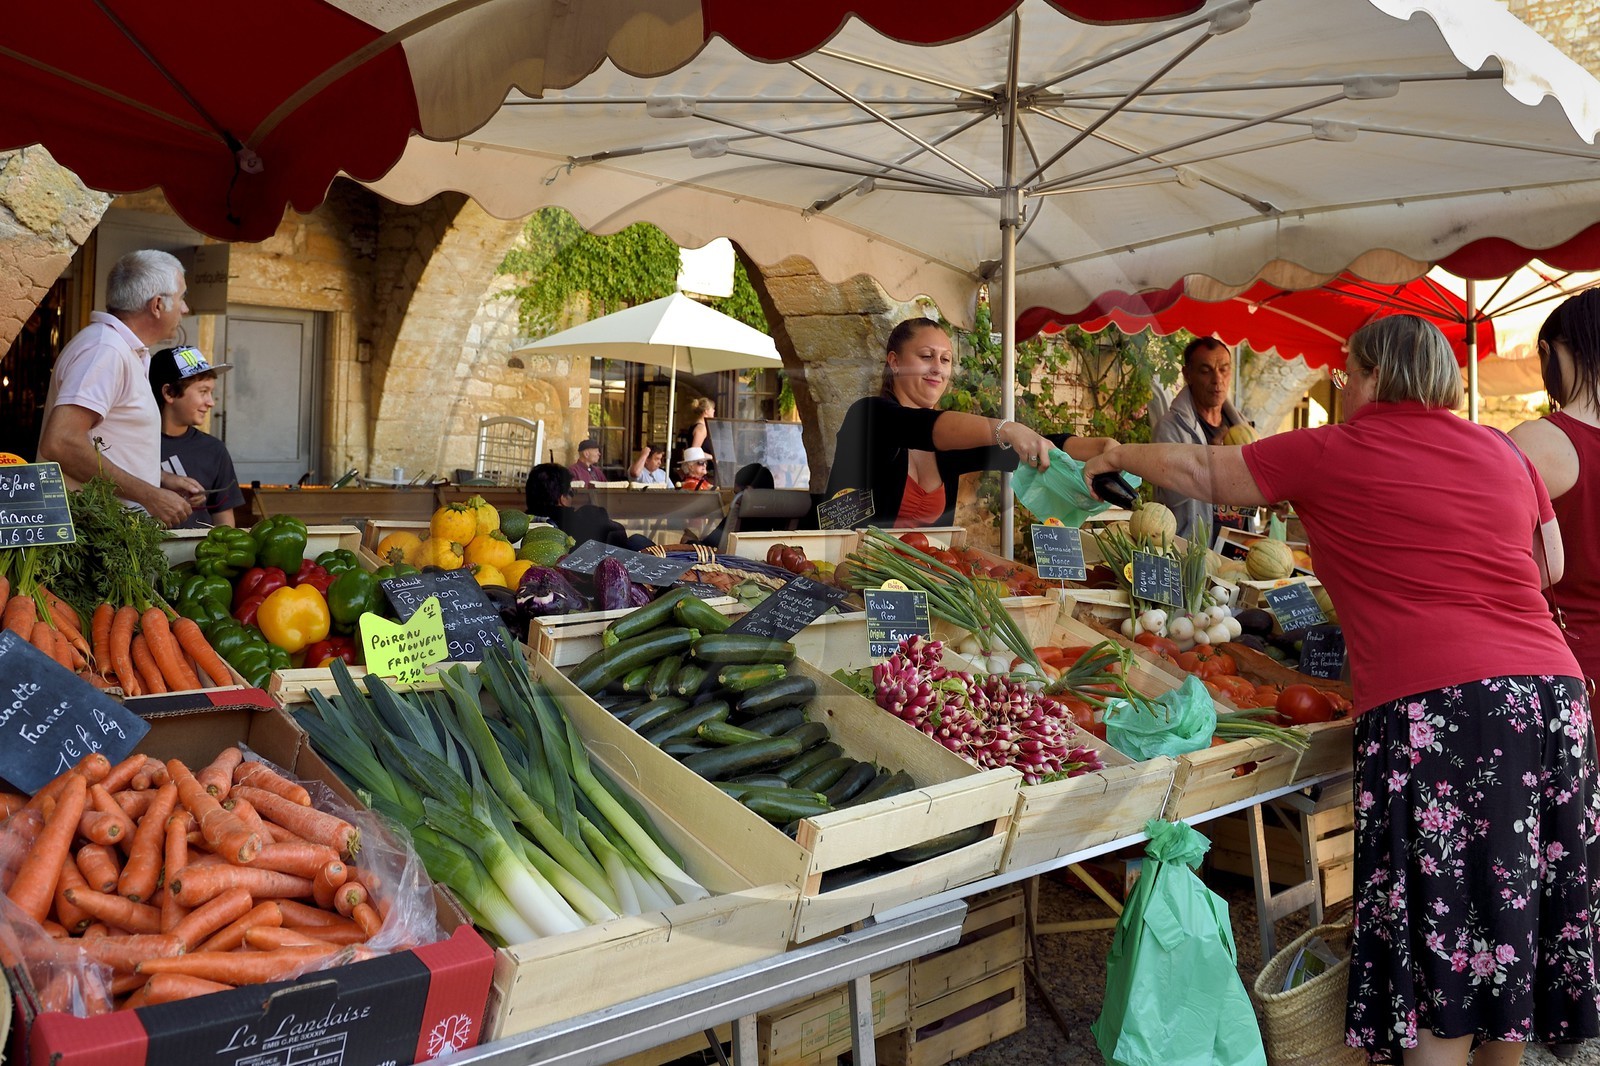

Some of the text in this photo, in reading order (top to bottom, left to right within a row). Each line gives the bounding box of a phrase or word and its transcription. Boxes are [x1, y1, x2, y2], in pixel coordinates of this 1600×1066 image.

[870, 630, 886, 639] Origine
[0, 682, 41, 727] arotte
[215, 1003, 372, 1055] La Landaise
